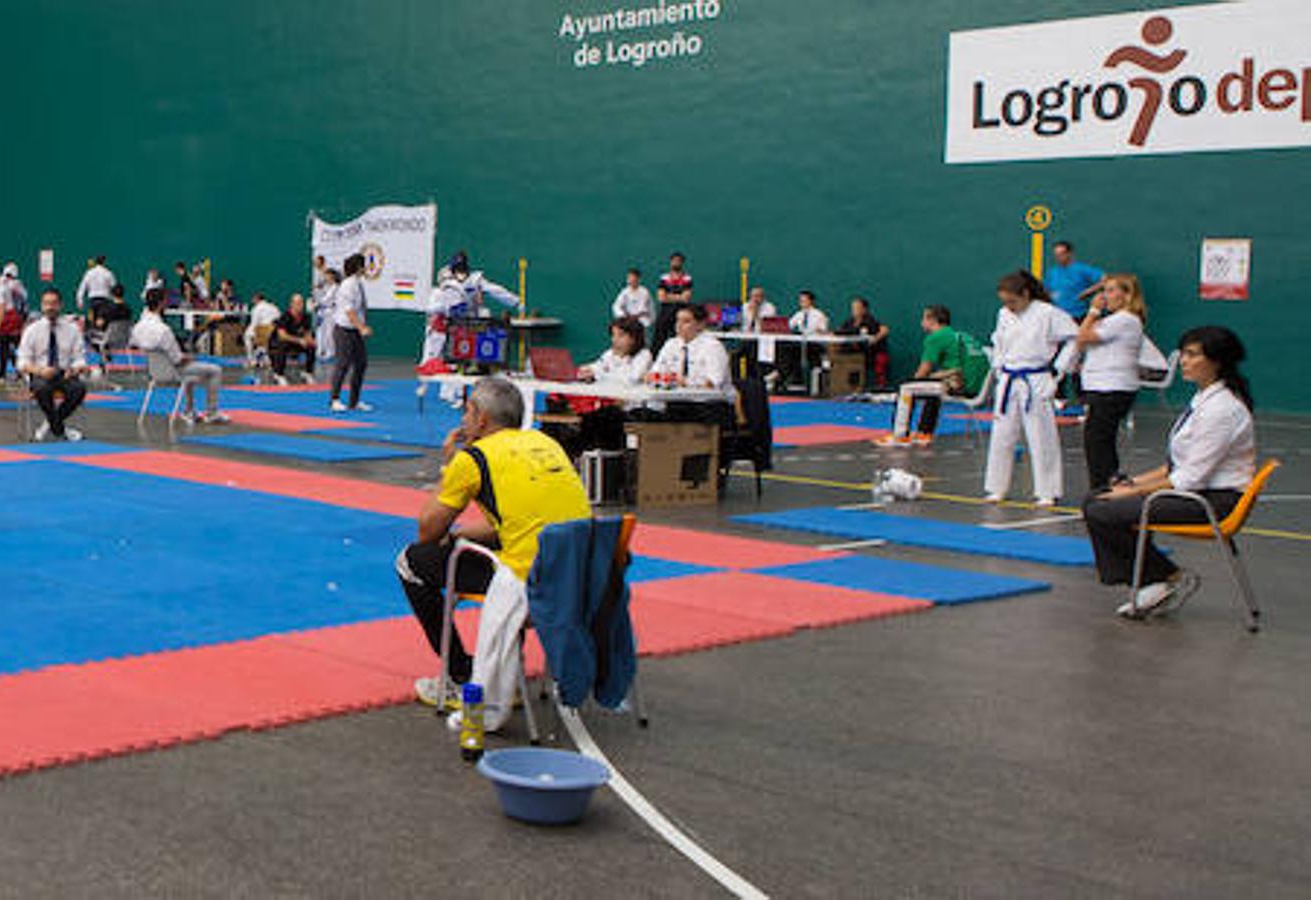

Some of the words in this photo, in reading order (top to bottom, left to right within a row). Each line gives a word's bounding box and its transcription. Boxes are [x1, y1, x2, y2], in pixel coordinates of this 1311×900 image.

[559, 0, 721, 40] Ayuntamiento
[574, 44, 601, 67] de
[606, 31, 703, 67] Logroño
[972, 44, 1207, 147] Logroño
[1216, 56, 1311, 123] de
